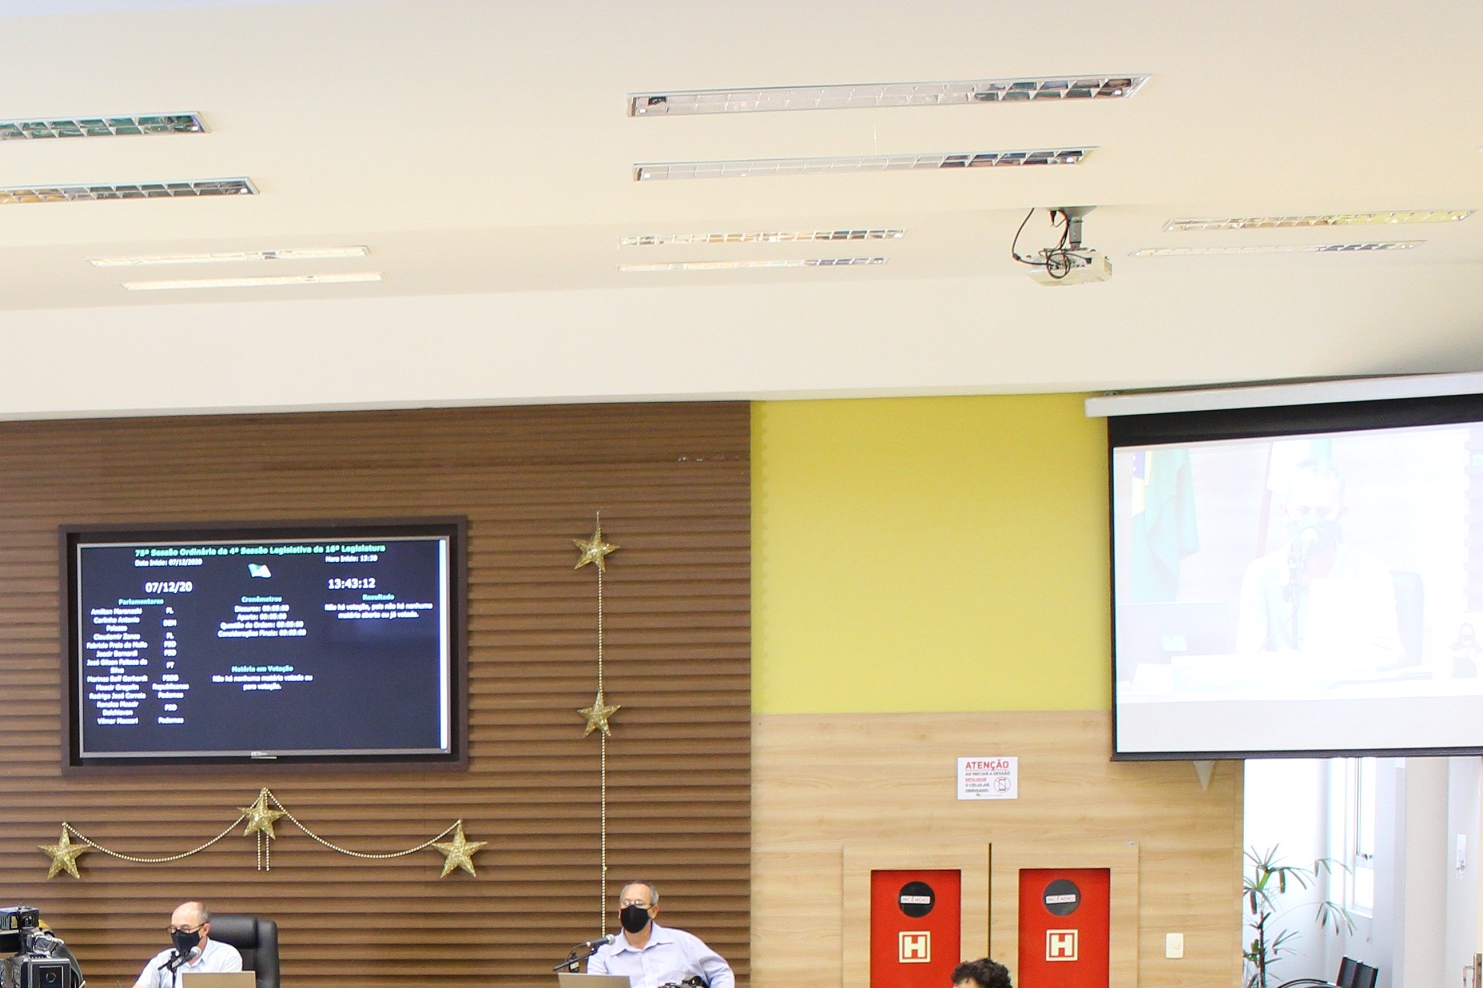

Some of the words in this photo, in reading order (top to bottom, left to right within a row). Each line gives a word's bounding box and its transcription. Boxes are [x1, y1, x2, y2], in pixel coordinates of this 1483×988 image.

[151, 548, 178, 556] Sessão
[180, 547, 216, 556] Ordinária
[240, 546, 268, 554] Sessão
[270, 546, 312, 555] Legislativa
[341, 544, 386, 553] Legislatura
[168, 558, 202, 566] 07/12/2020
[146, 581, 193, 593] 07/12/20
[328, 578, 376, 589] 13:43:12
[268, 665, 293, 673] Votação
[965, 759, 1010, 771] ATENÇÃO
[904, 936, 926, 958] H
[1051, 934, 1072, 956] H
